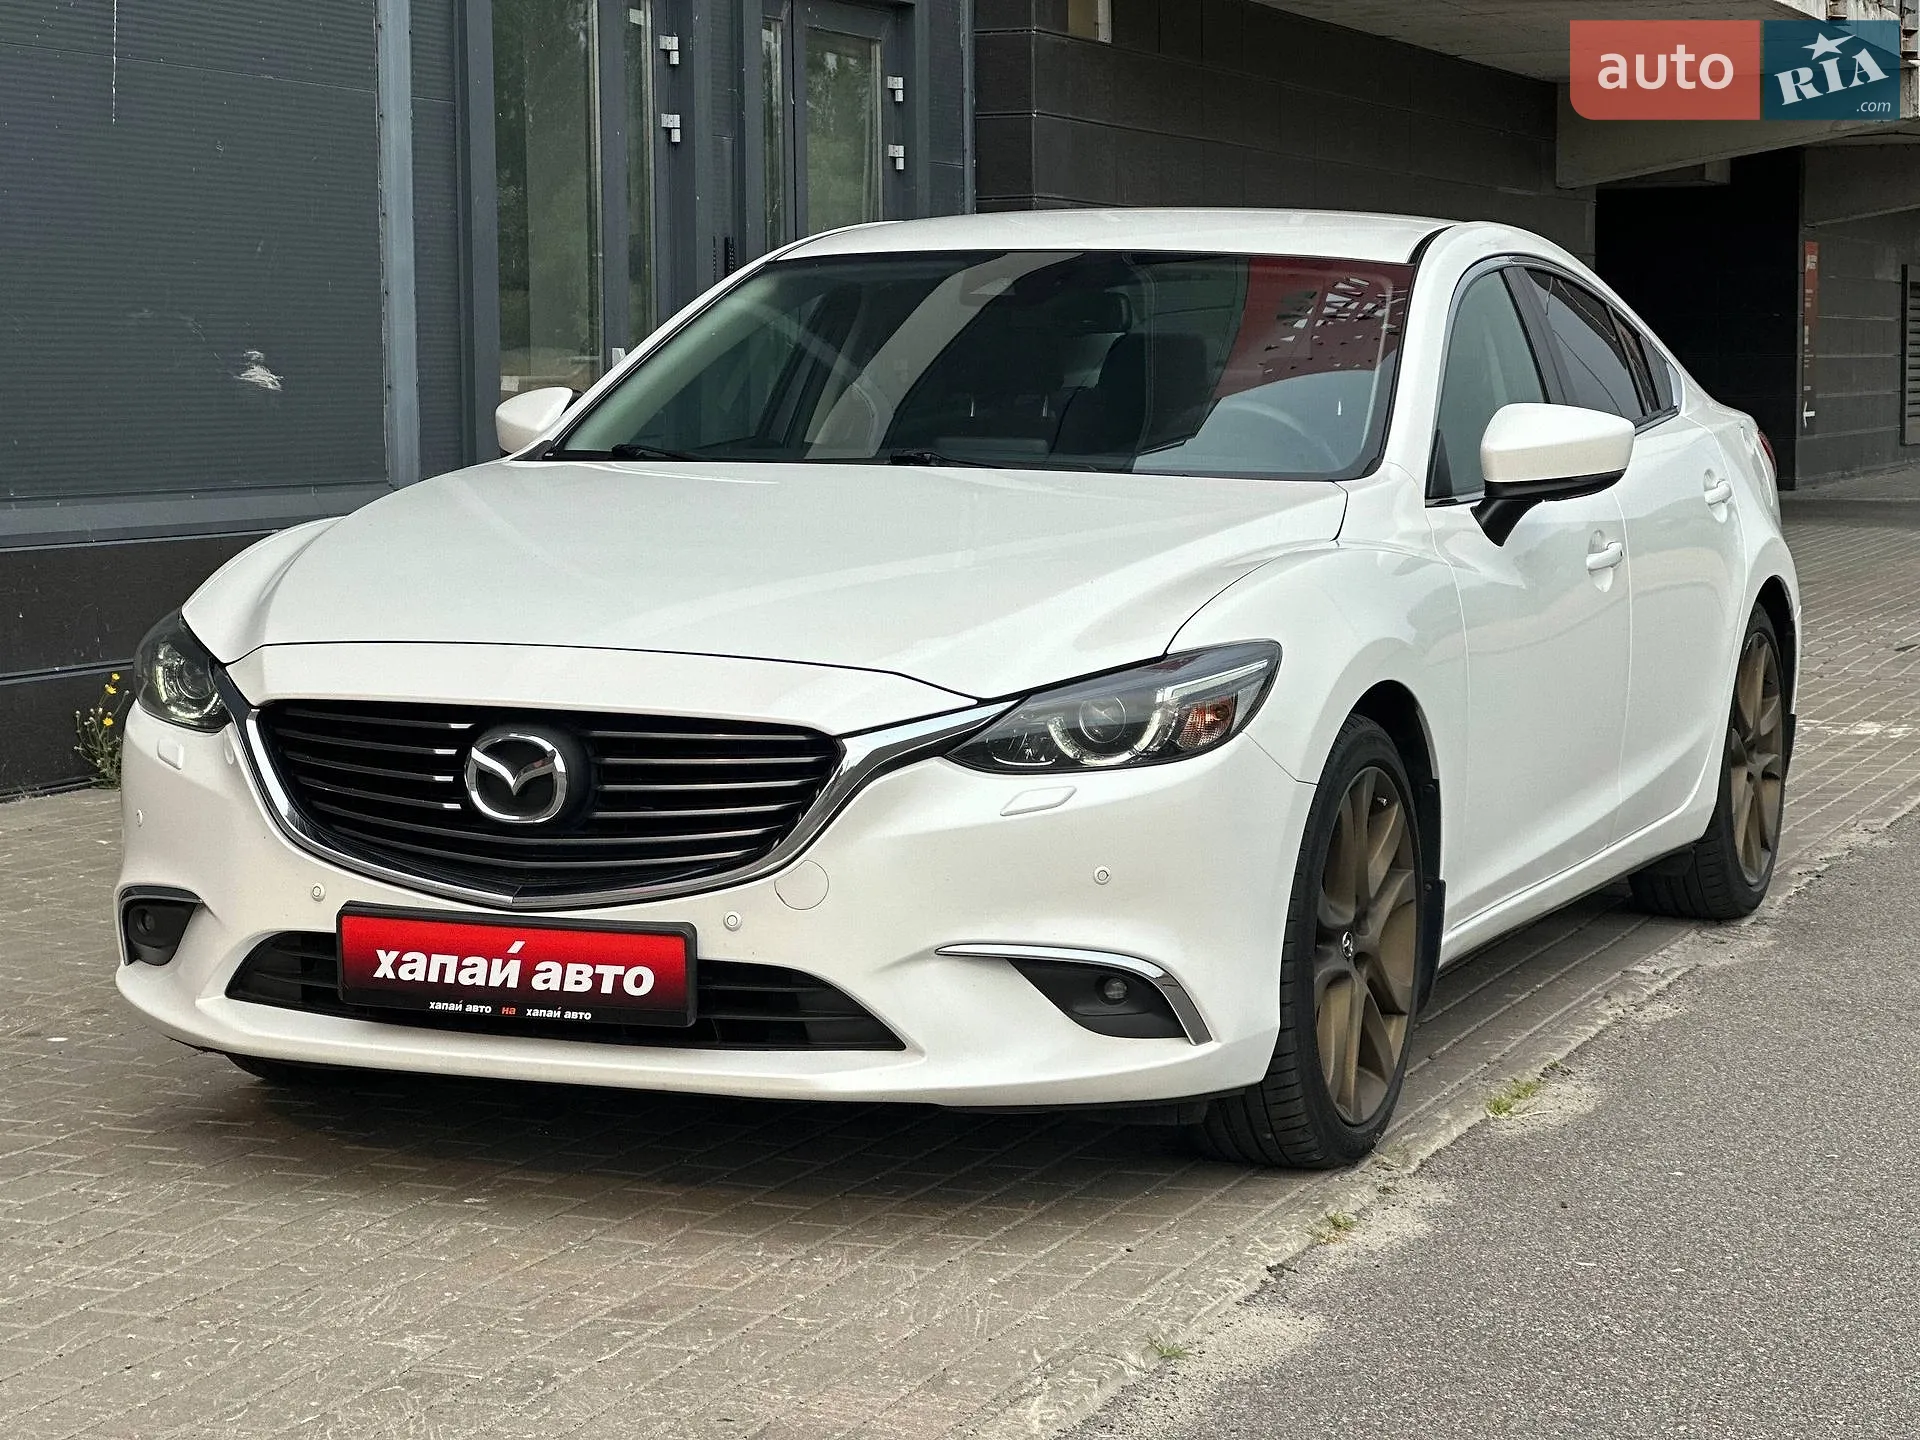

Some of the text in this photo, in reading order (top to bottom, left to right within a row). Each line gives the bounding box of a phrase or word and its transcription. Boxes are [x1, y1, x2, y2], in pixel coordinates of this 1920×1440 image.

[531, 960, 656, 997] авто
[465, 1003, 492, 1014] авто
[501, 1006, 517, 1015] на
[563, 1010, 592, 1021] авто
